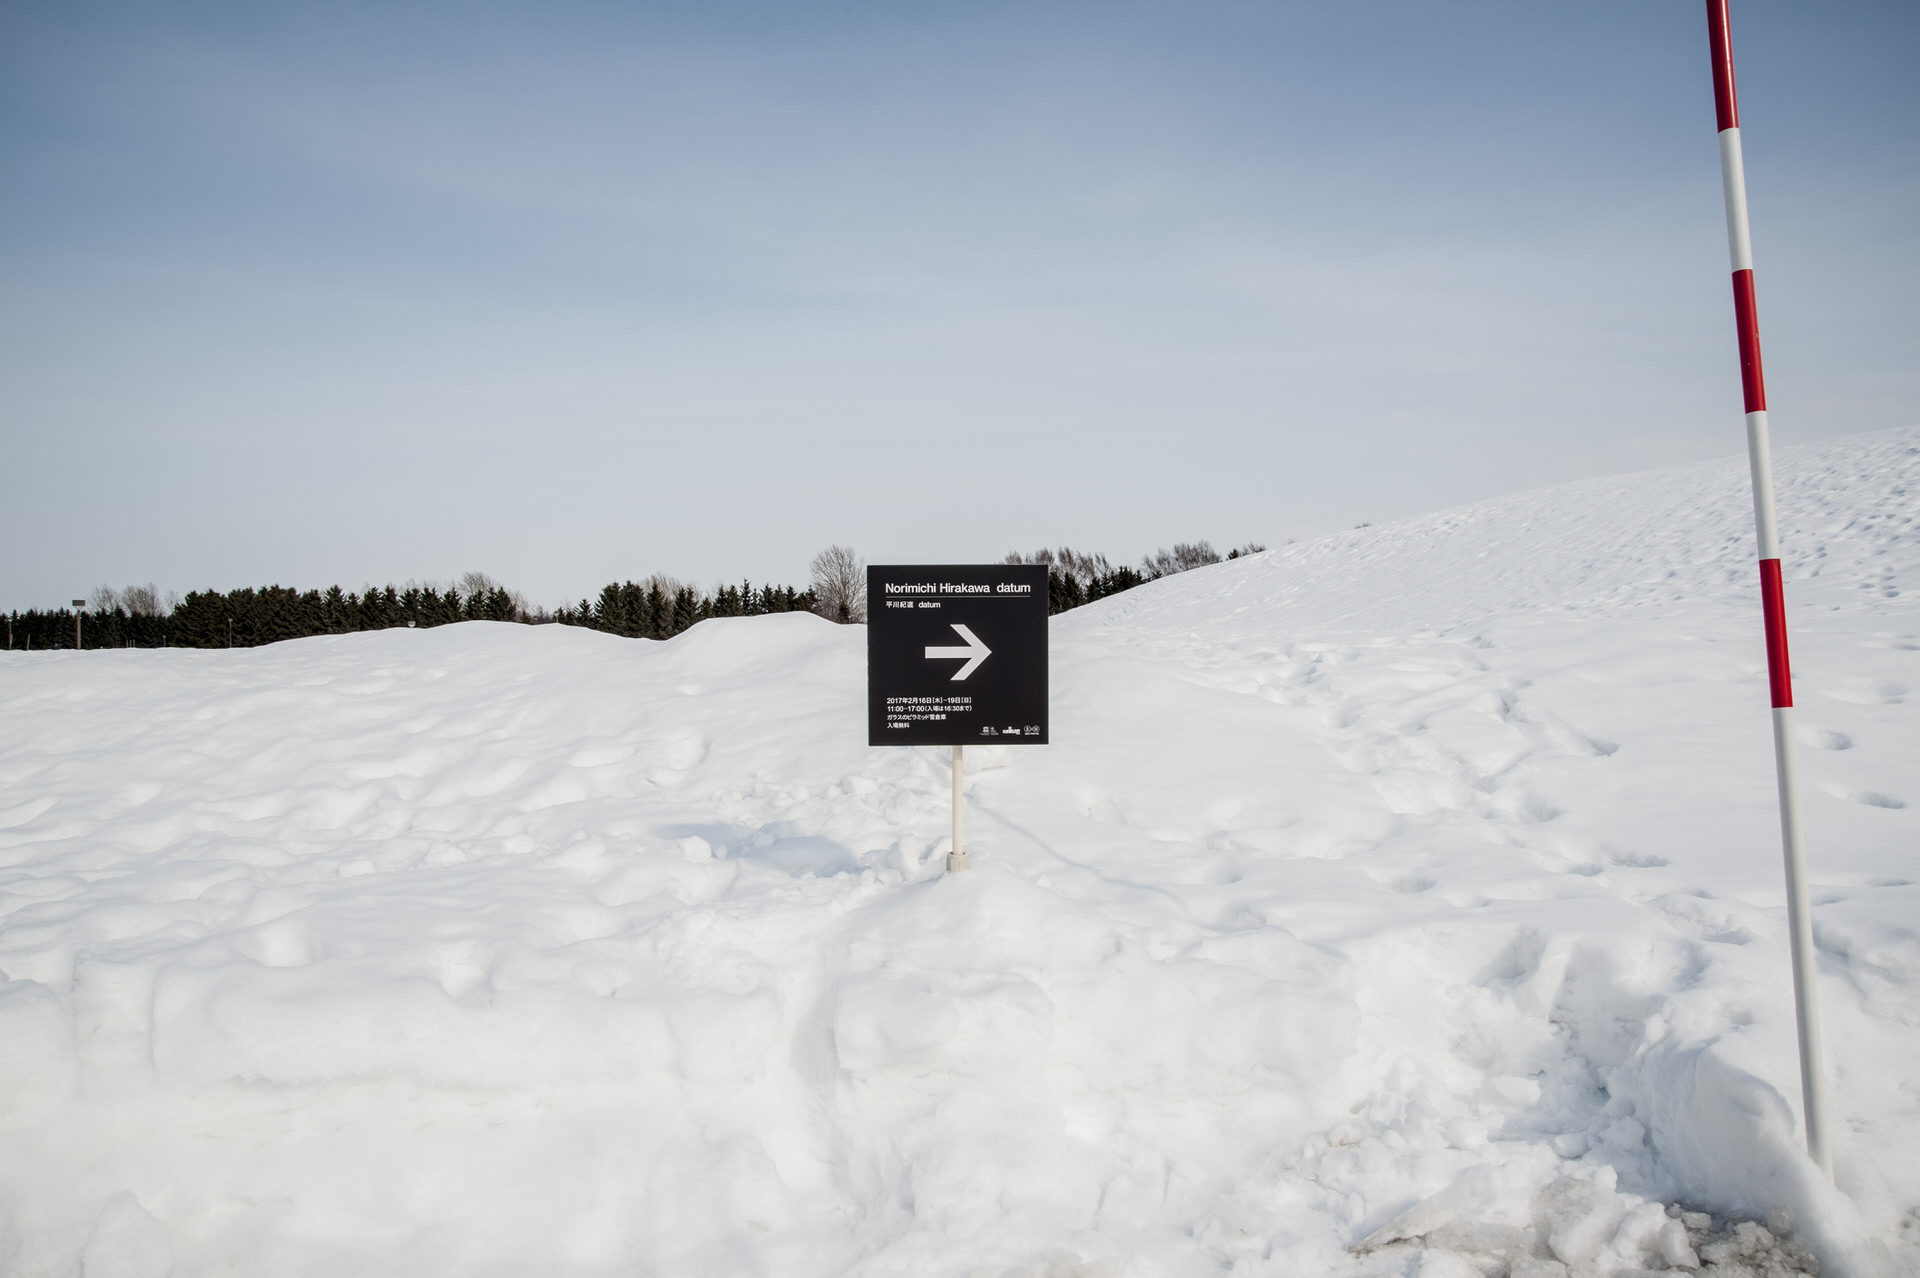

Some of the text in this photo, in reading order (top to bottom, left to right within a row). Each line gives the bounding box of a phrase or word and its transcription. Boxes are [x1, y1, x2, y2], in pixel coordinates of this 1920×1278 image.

[885, 582, 1031, 594] Norimichi Hirakawa datum
[918, 600, 941, 609] datum
